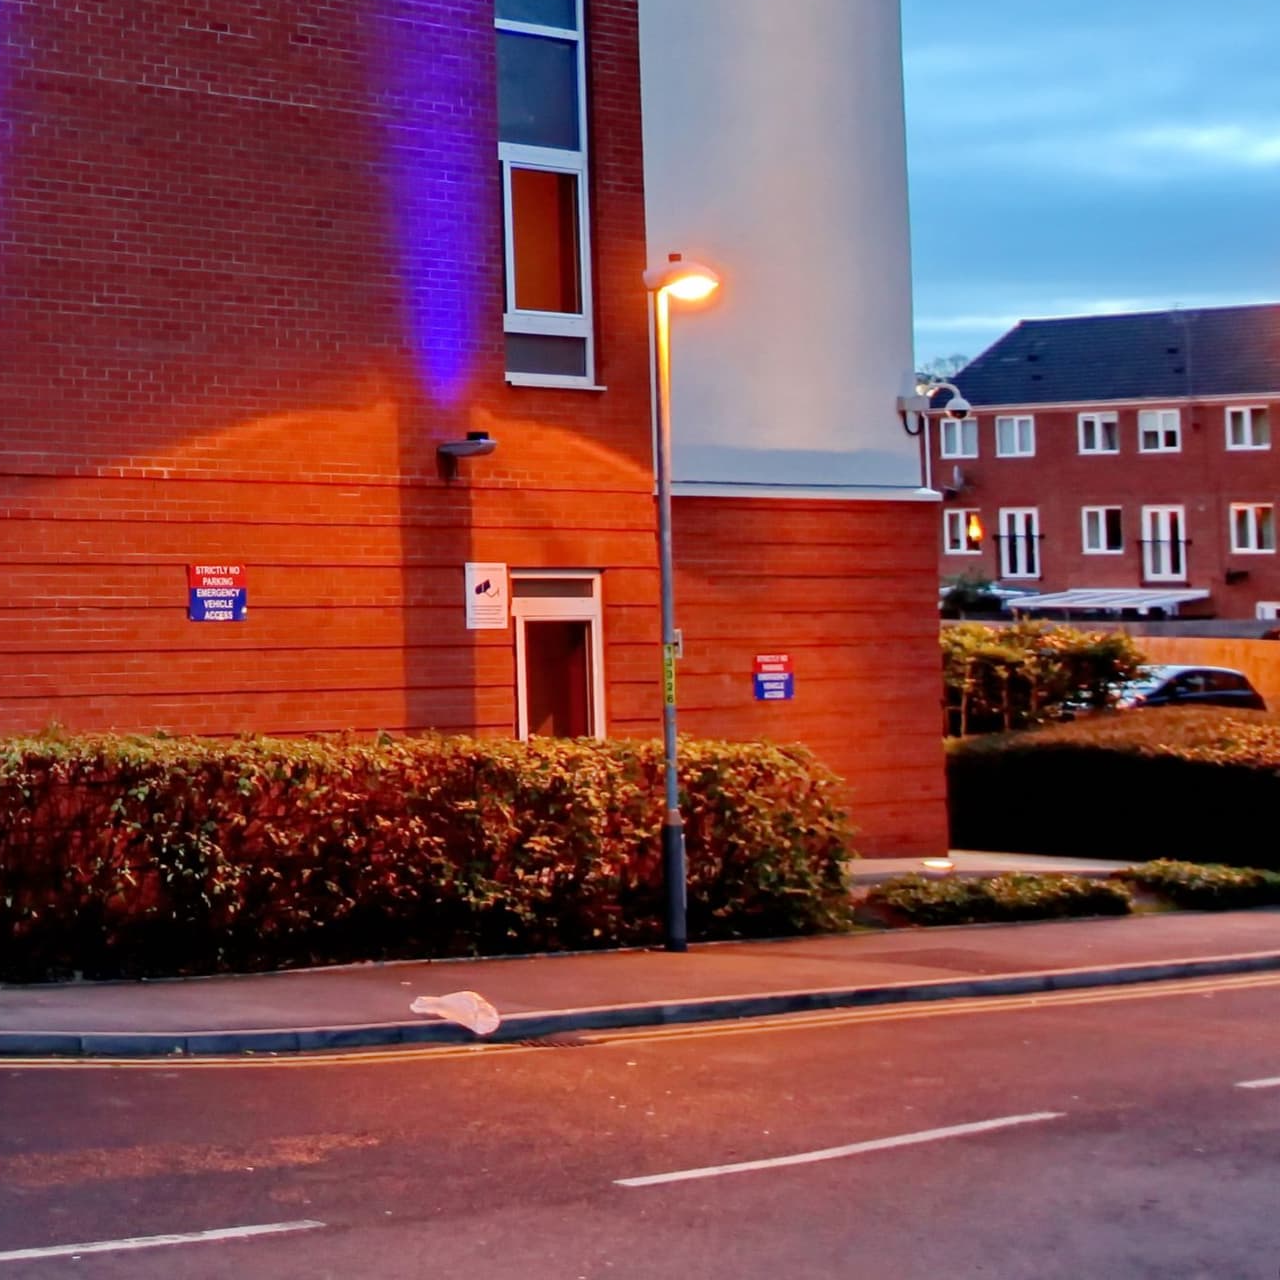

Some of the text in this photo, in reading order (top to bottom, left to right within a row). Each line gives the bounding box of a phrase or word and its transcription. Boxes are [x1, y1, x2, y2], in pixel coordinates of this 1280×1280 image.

[195, 566, 240, 575] STRICTLY NO
[202, 577, 233, 586] PARKING
[196, 588, 240, 597] EMERGENCY
[203, 600, 234, 608] VEHICLE
[204, 611, 233, 620] ACCESS
